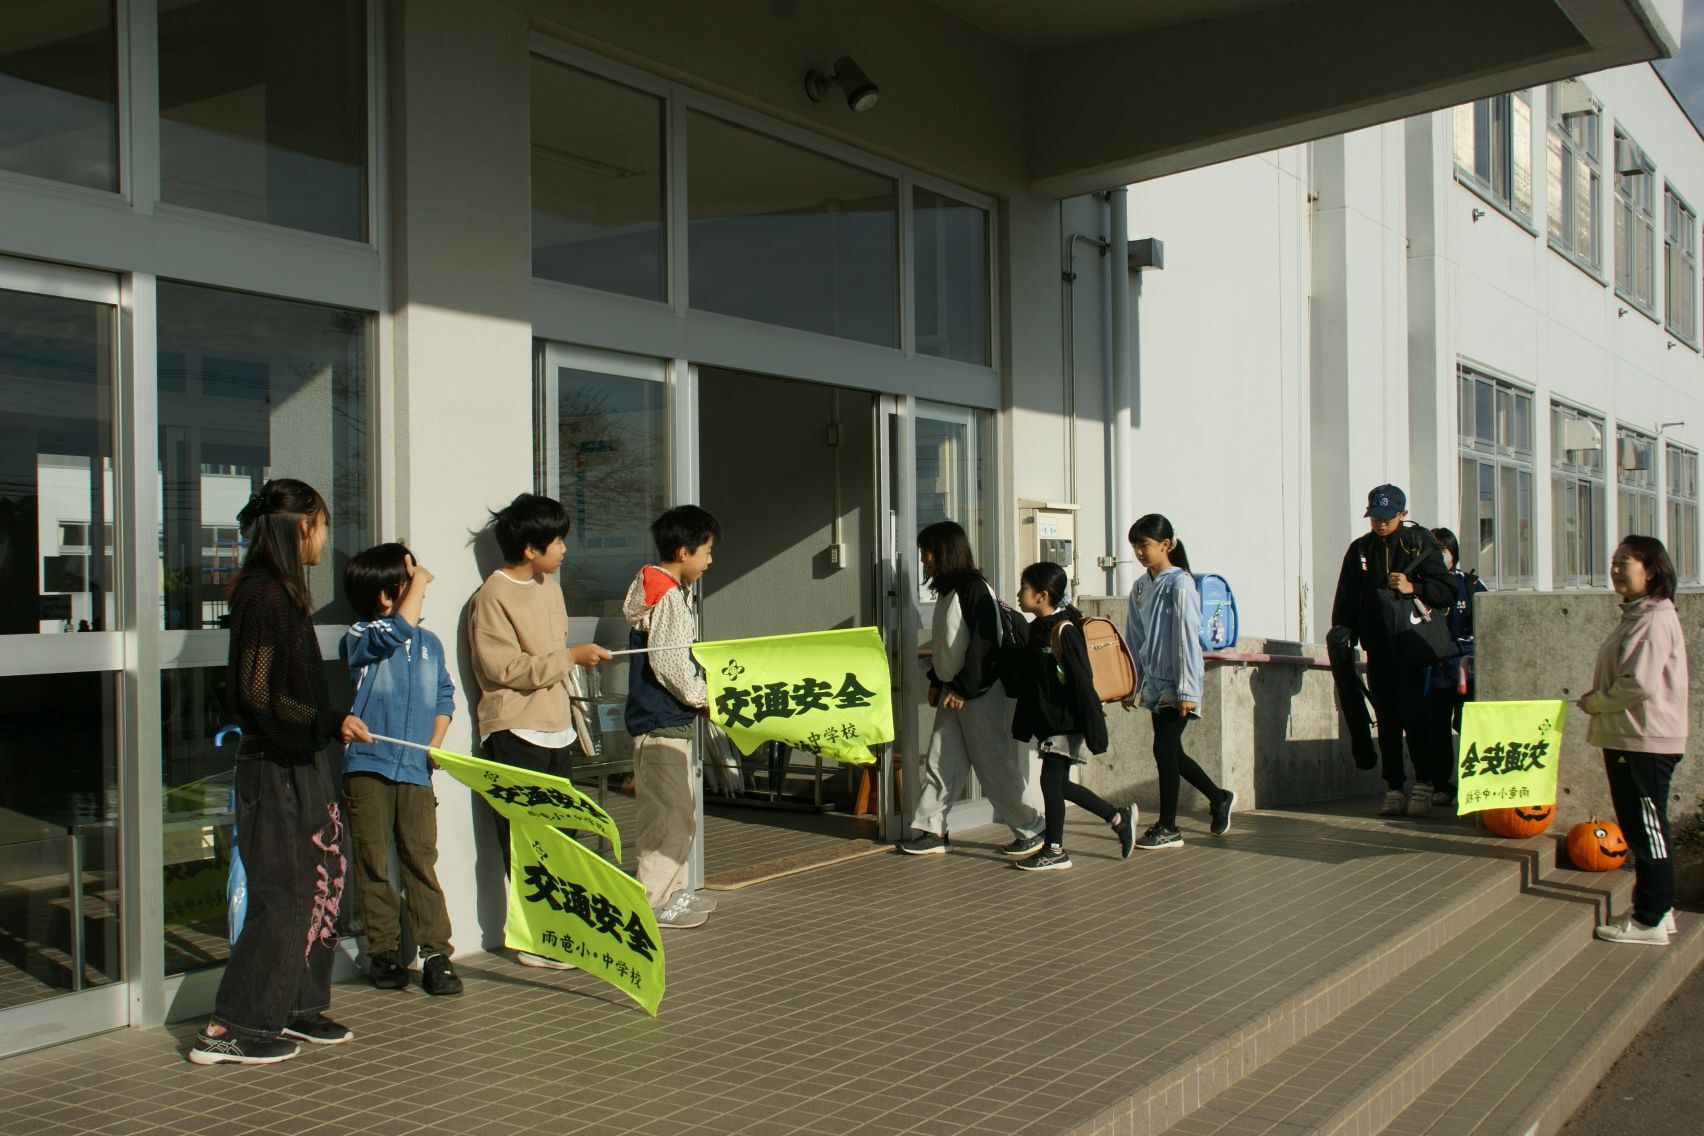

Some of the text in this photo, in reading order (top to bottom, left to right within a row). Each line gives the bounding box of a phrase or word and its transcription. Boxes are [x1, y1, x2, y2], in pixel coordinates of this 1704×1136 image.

[714, 672, 877, 729] 交通安全
[485, 783, 609, 825] 交通安全
[523, 861, 658, 962] 交通安全
[541, 930, 643, 990] 雨竜小・中学校
